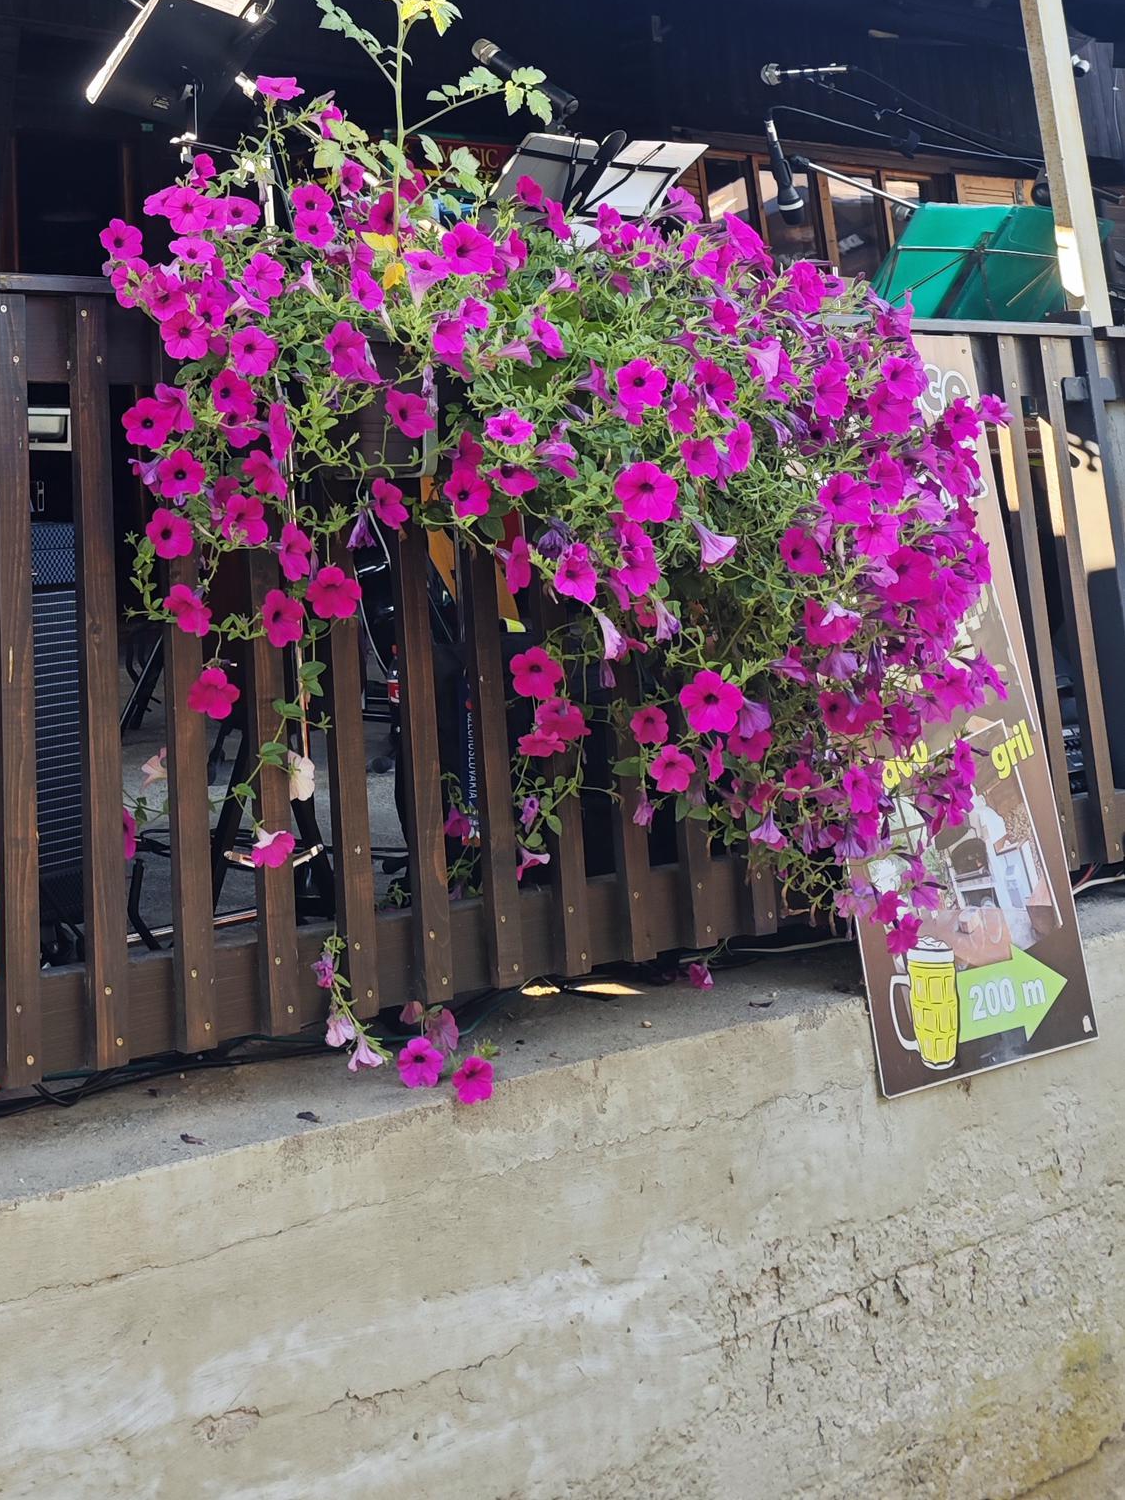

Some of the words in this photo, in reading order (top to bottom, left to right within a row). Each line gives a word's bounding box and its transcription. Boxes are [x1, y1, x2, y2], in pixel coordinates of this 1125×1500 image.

[991, 719, 1035, 780] gril
[969, 978, 1015, 1021] 200
[1022, 978, 1046, 1007] m
